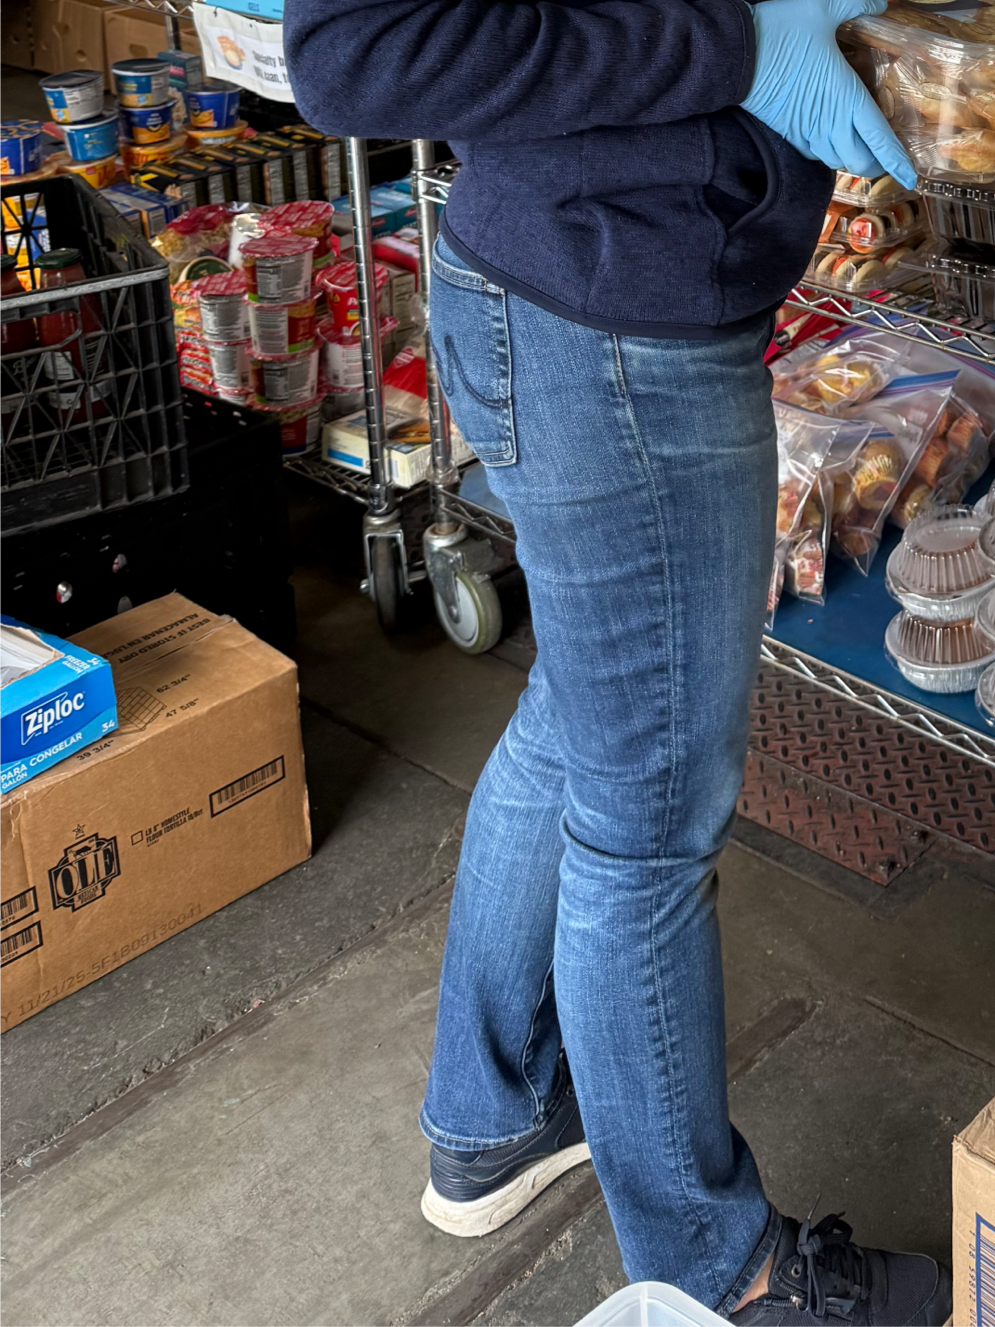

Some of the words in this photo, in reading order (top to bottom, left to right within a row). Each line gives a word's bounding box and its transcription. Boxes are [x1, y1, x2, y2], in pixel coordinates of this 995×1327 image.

[143, 613, 199, 641] ALMACENAR
[188, 618, 211, 631] BEST
[126, 638, 143, 650] EN
[138, 635, 177, 655] STORED
[65, 654, 91, 670] FREEZER
[87, 656, 101, 666] 34
[118, 651, 139, 664] DRY
[156, 684, 170, 694] 62
[25, 691, 86, 734] Ziploc
[165, 709, 177, 718] 47
[1, 764, 28, 783] PARA
[29, 732, 83, 767] CONGELAR
[101, 719, 115, 733] 34
[76, 751, 91, 761] 39
[1, 771, 28, 789] GALÓN
[160, 807, 190, 828] HOMESTYLE
[146, 830, 163, 844] FLOUR
[163, 818, 187, 835] TORTILLA
[968, 1243, 976, 1258] 08
[968, 1265, 976, 1302] 59872
